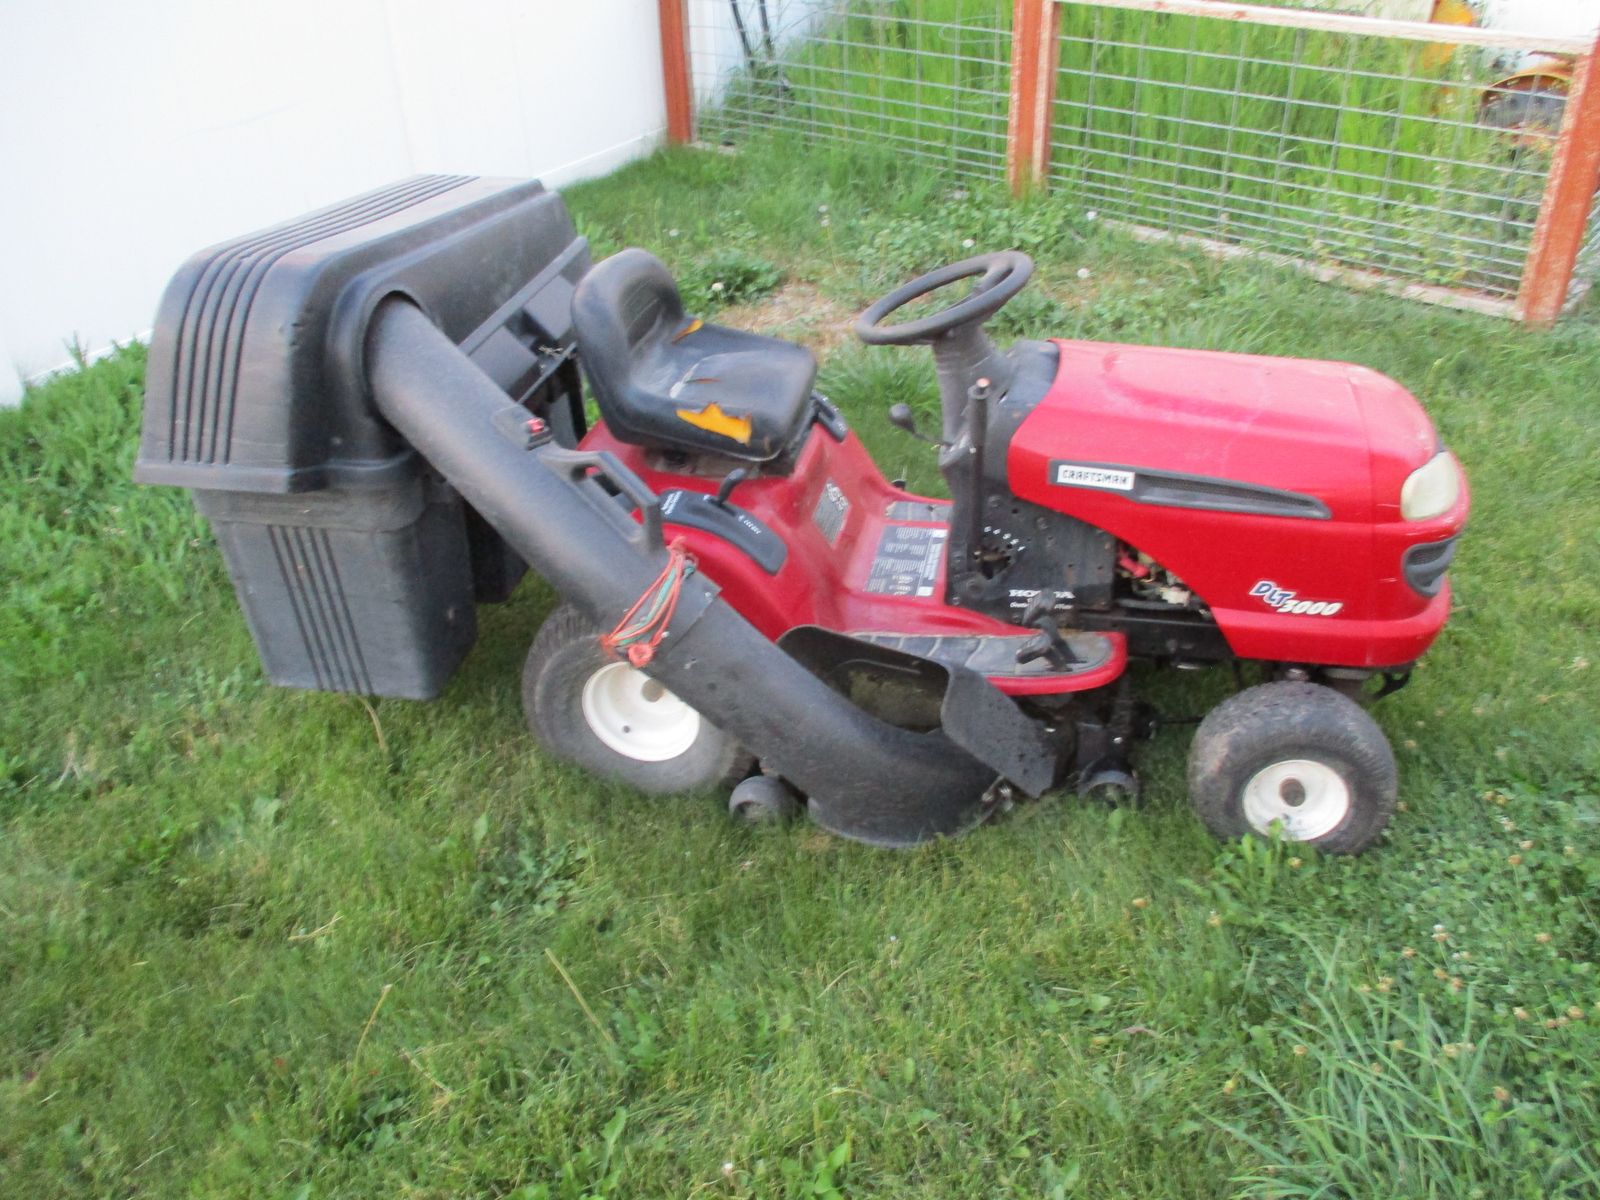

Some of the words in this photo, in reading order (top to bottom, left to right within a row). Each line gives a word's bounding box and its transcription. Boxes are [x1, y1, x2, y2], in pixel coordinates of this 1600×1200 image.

[1062, 469, 1130, 485] CRAFTSMAN
[1248, 580, 1297, 607] DLT
[1276, 599, 1343, 616] 3000
